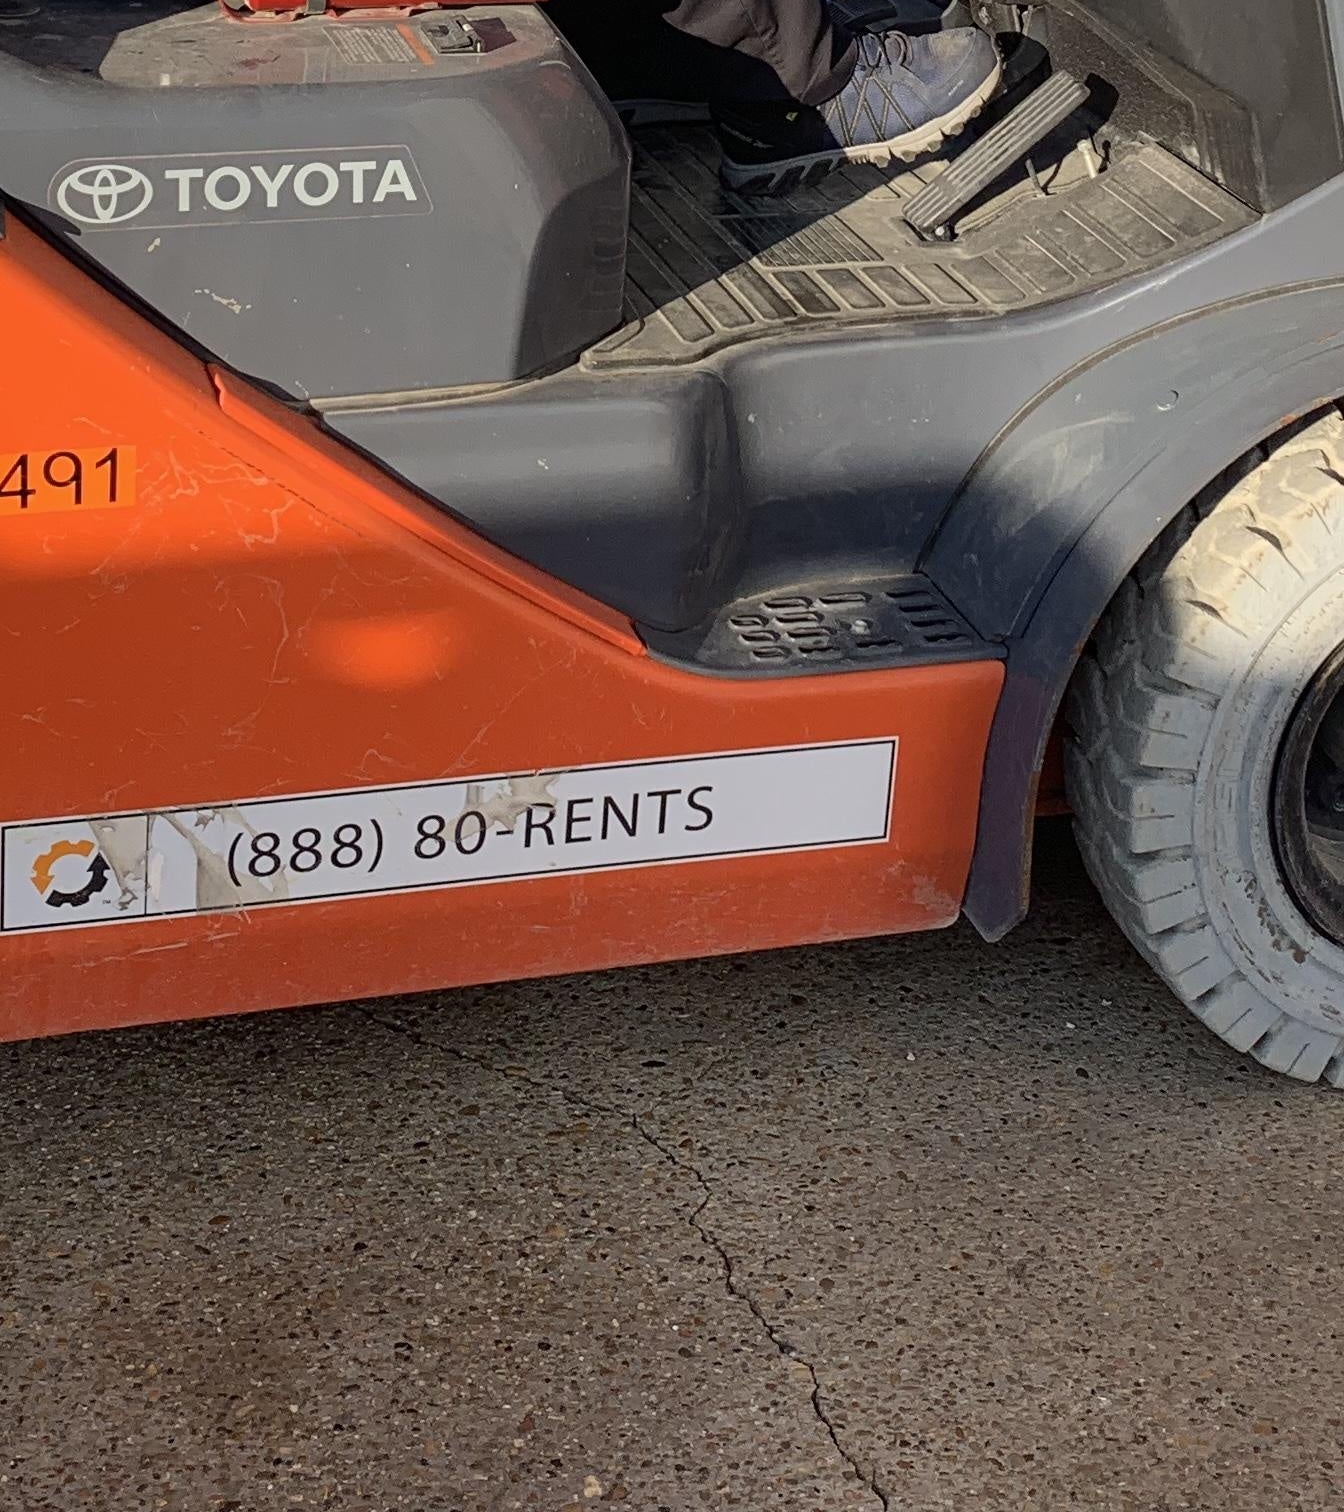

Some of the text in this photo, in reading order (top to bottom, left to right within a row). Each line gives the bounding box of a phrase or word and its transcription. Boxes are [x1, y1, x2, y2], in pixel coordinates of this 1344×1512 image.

[164, 159, 419, 213] TOYOTA
[227, 785, 715, 887] (888) 80-RENTS
